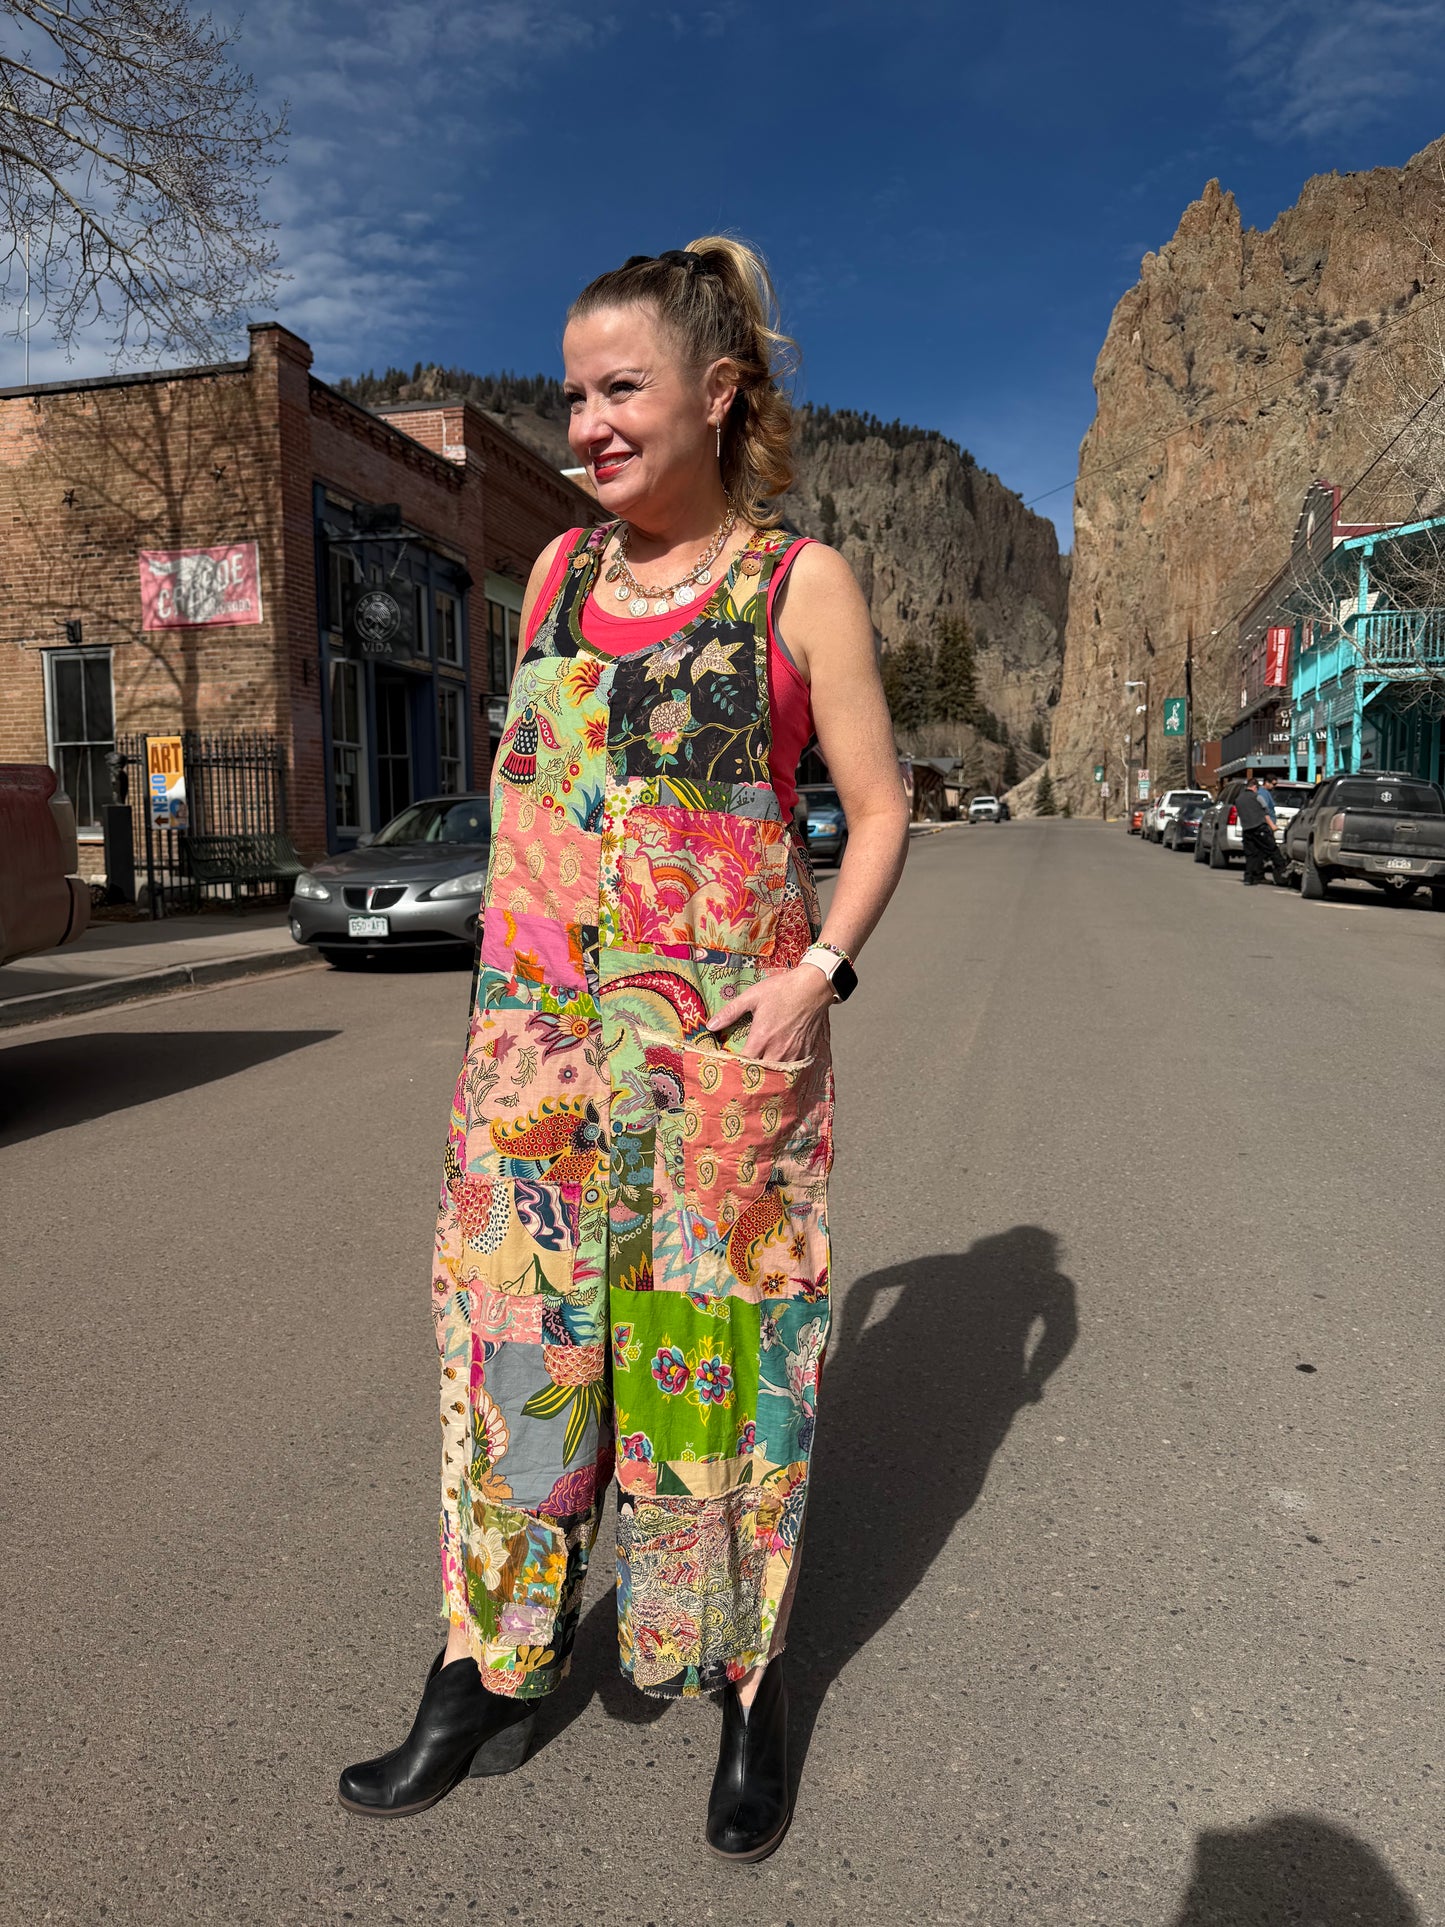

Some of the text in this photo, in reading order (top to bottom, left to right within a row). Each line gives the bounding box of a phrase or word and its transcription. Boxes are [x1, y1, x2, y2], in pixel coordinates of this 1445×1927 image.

[361, 642, 393, 653] VIDA
[151, 743, 181, 774] ART
[151, 774, 169, 813] OPEN
